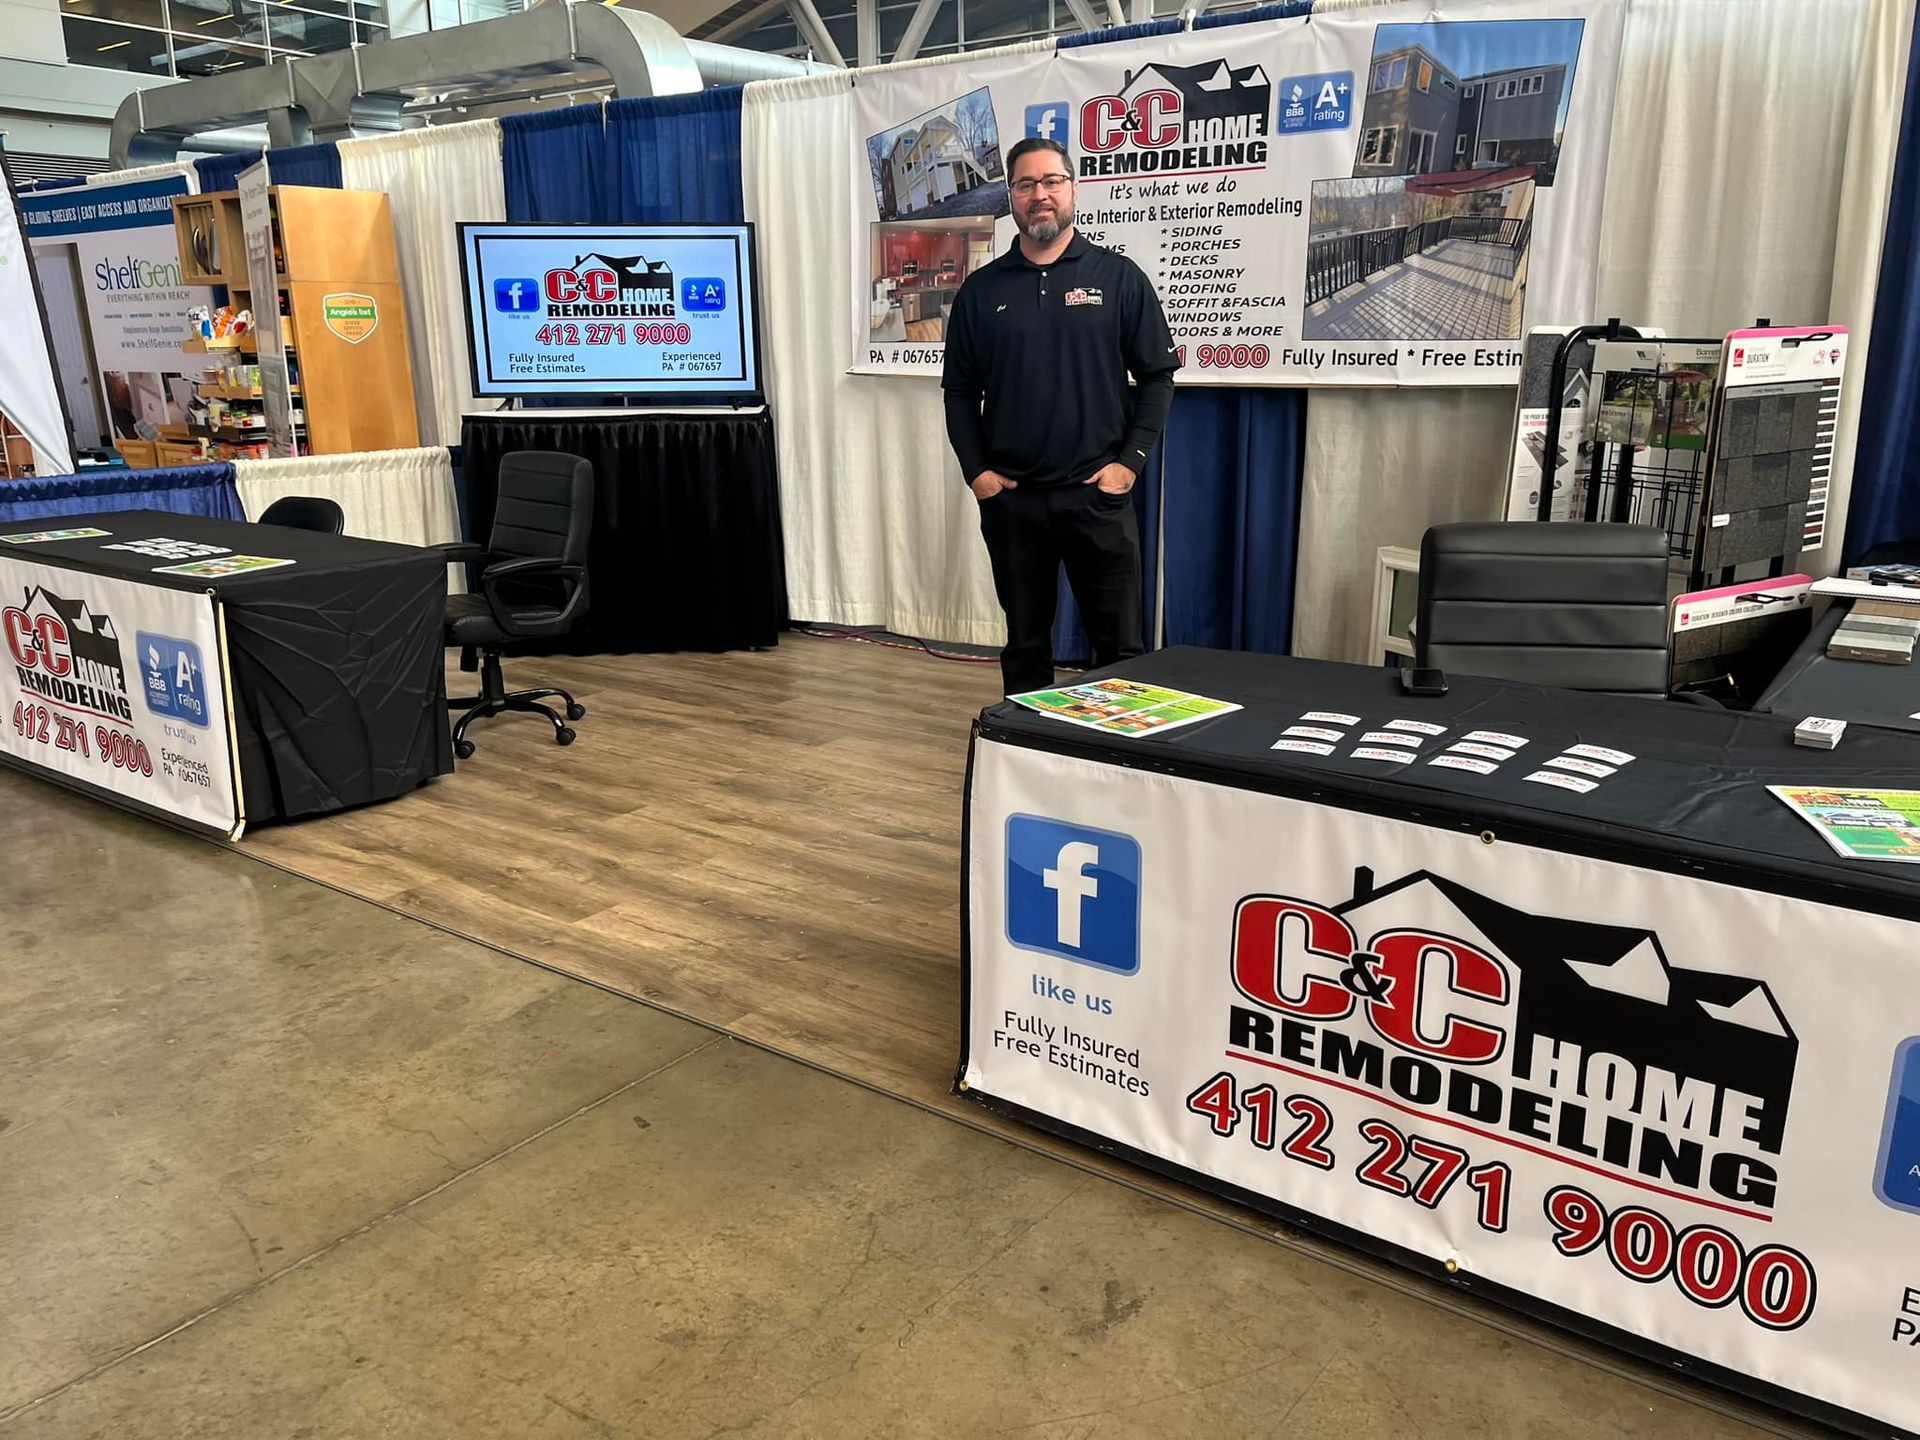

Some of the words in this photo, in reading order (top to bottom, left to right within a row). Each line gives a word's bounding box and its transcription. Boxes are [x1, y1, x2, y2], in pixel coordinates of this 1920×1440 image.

[1080, 88, 1181, 153] C&C
[1188, 113, 1262, 144] HOME
[1286, 107, 1304, 117] BBB
[1314, 109, 1345, 122] rating
[1080, 141, 1268, 177] REMODELING
[1110, 183, 1132, 201] It's
[1139, 180, 1180, 198] what
[1186, 181, 1209, 195] we
[1217, 175, 1237, 193] do
[52, 207, 77, 222] SHELVES
[81, 205, 97, 220] EASY
[98, 202, 123, 218] ACCESS
[123, 200, 137, 215] AND
[138, 193, 185, 213] ORGANIZA
[1097, 207, 1146, 224] Interior
[1148, 206, 1157, 222] &
[1160, 203, 1214, 221] Exterior
[1217, 197, 1303, 217] Remodeling
[1171, 225, 1223, 238] SIDING
[1171, 239, 1242, 252] PORCHES
[1170, 255, 1219, 266] DECKS
[95, 255, 183, 291] ShelfGeni
[1169, 268, 1246, 281] MASONRY
[544, 268, 617, 303] C&C
[622, 288, 671, 302] HOME
[1168, 283, 1237, 295] ROOFING
[547, 303, 676, 317] REMODELING
[1167, 298, 1219, 309] SOFFIT
[1168, 312, 1242, 323] WINDOWS
[536, 323, 580, 345] 412
[586, 323, 626, 345] 271
[634, 323, 691, 344] 9000
[1169, 327, 1218, 337] DOORS
[1222, 326, 1232, 336] &
[1237, 326, 1283, 336] MORE
[121, 338, 182, 350] www.ShelfGenie.co
[509, 353, 534, 365] Fully
[537, 353, 575, 362] Insured
[662, 351, 721, 362] Experienced
[869, 350, 885, 363] PA
[891, 350, 899, 363] #
[903, 349, 945, 364] 067657
[1196, 344, 1270, 368] 9000
[1282, 348, 1325, 369] Fully
[1332, 349, 1398, 366] Insured
[1422, 349, 1466, 366] Free
[510, 364, 533, 373] Free
[536, 364, 586, 373] Estimates
[662, 362, 674, 371] PA
[679, 362, 685, 370] #
[688, 362, 722, 371] 067657
[2, 607, 71, 677] C&C
[76, 656, 122, 692] HOME
[148, 677, 166, 691] BBB
[16, 665, 133, 722] REMODELING
[13, 700, 50, 743] 412
[95, 725, 154, 778] 9000
[163, 762, 174, 777] PA
[1032, 974, 1076, 1004] like
[1085, 994, 1113, 1015] us
[1230, 892, 1511, 1066] C&C
[1530, 1033, 1764, 1150] HOME
[1004, 1010, 1056, 1043] Fully
[1064, 1026, 1140, 1069] Insured
[994, 1030, 1041, 1058] Free
[1048, 1044, 1150, 1097] Estimates
[1228, 1005, 1778, 1209] REMODELING
[1186, 1071, 1336, 1171] 412
[1355, 1118, 1511, 1234] 271
[1543, 1184, 1818, 1332] 9000
